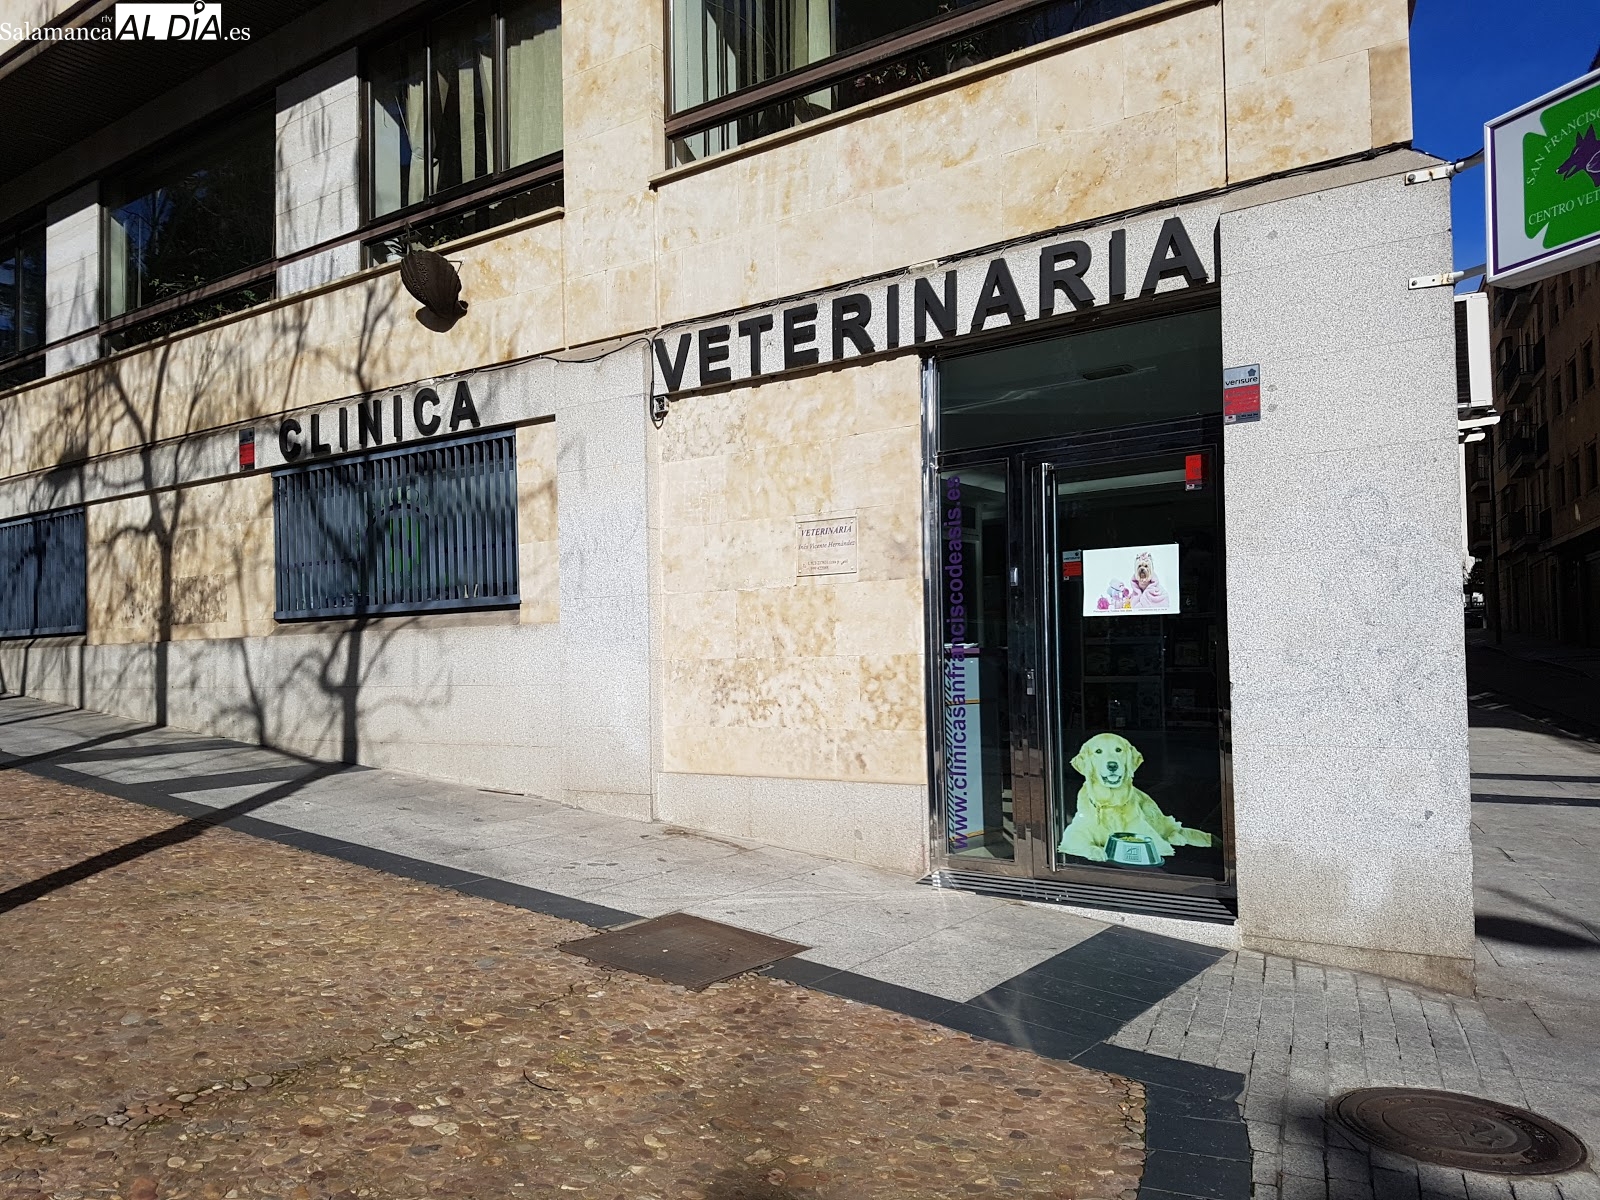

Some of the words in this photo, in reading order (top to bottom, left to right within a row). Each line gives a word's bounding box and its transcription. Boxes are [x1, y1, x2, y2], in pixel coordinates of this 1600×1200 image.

[1527, 154, 1545, 185] SAN
[1528, 200, 1575, 225] CENTRO
[653, 216, 1210, 396] VETERINARIA
[1225, 376, 1258, 386] verisure
[278, 380, 481, 463] CLINICA
[801, 526, 852, 536] VETERINARIA
[944, 475, 968, 850] www.clinicasanfranciscodeasis.es
